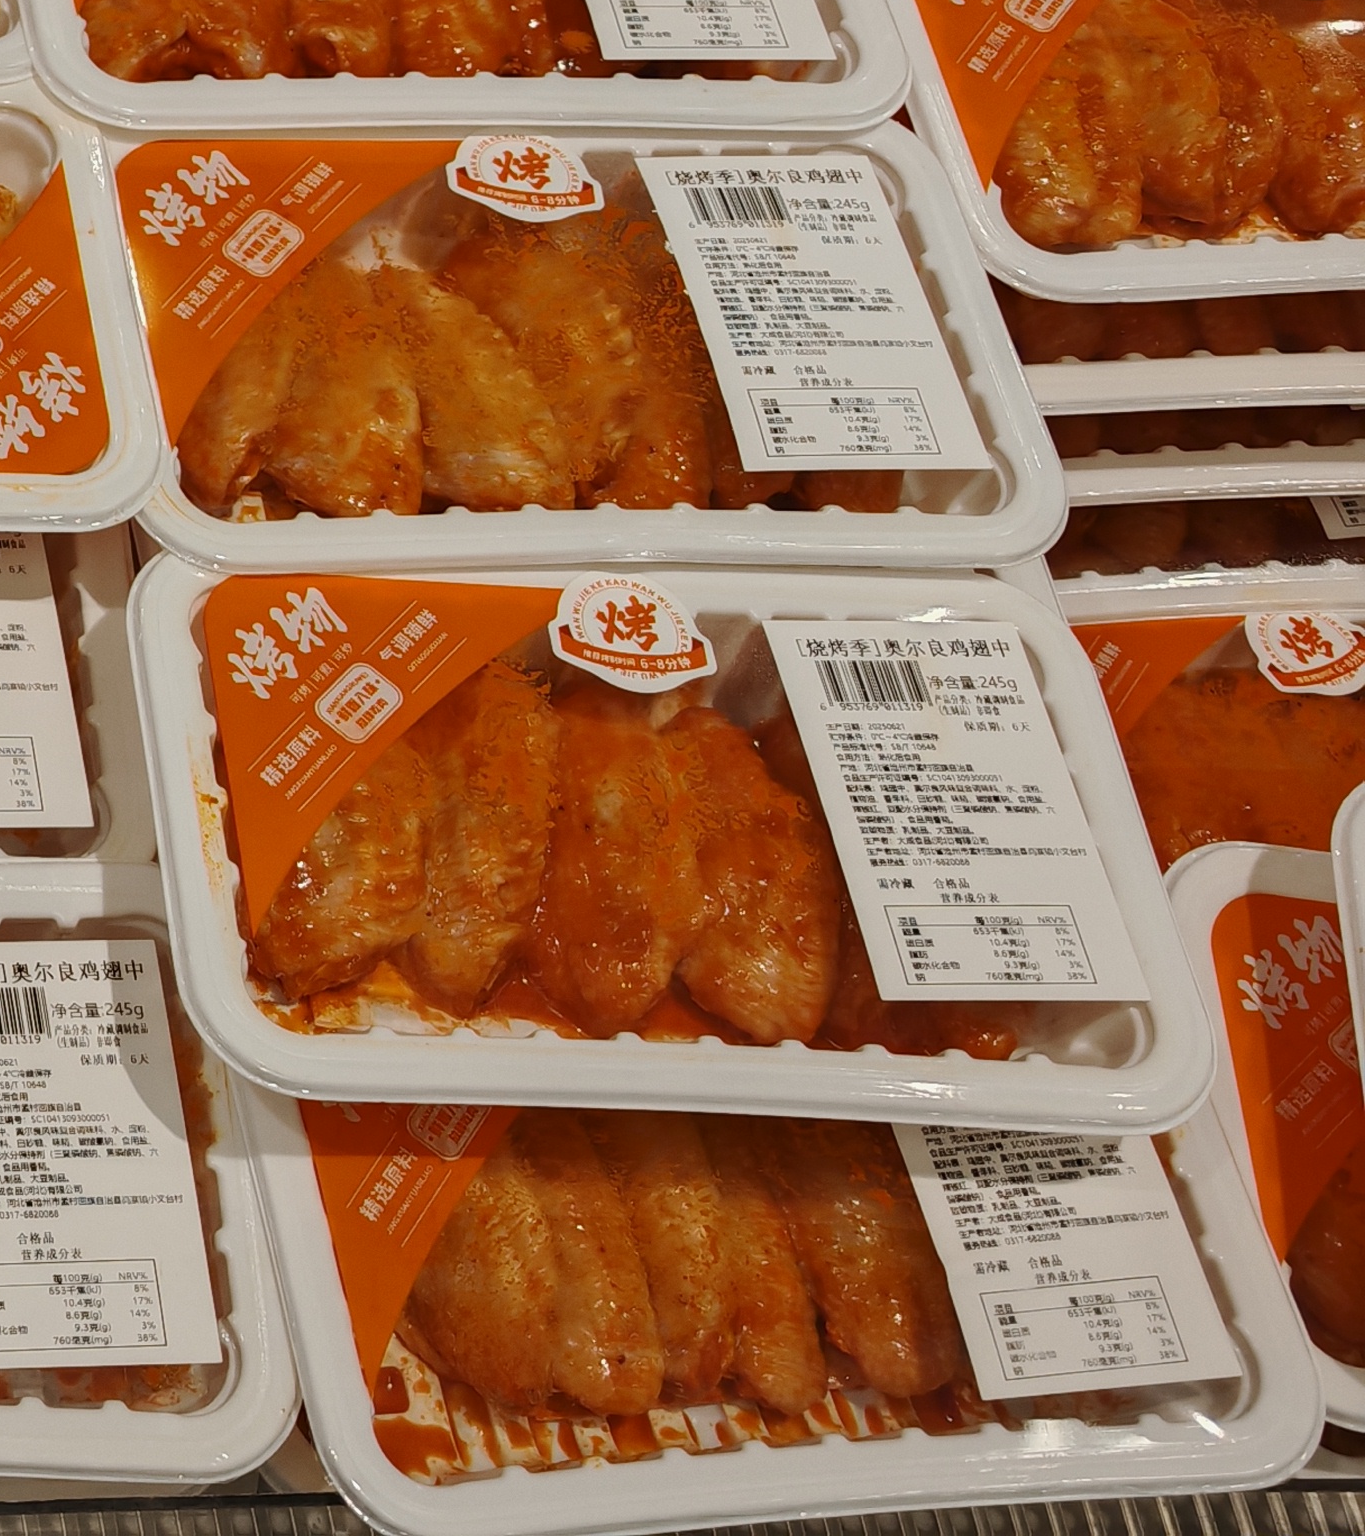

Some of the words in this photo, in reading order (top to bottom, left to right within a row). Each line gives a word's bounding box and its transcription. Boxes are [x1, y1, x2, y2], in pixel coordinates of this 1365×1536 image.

[968, 22, 1015, 72] 精选原料
[492, 146, 551, 190] 烤
[174, 265, 230, 318] 精选原料
[596, 595, 658, 651] 烤
[261, 725, 322, 786] 精选原料
[359, 1147, 417, 1221] 精选原料
